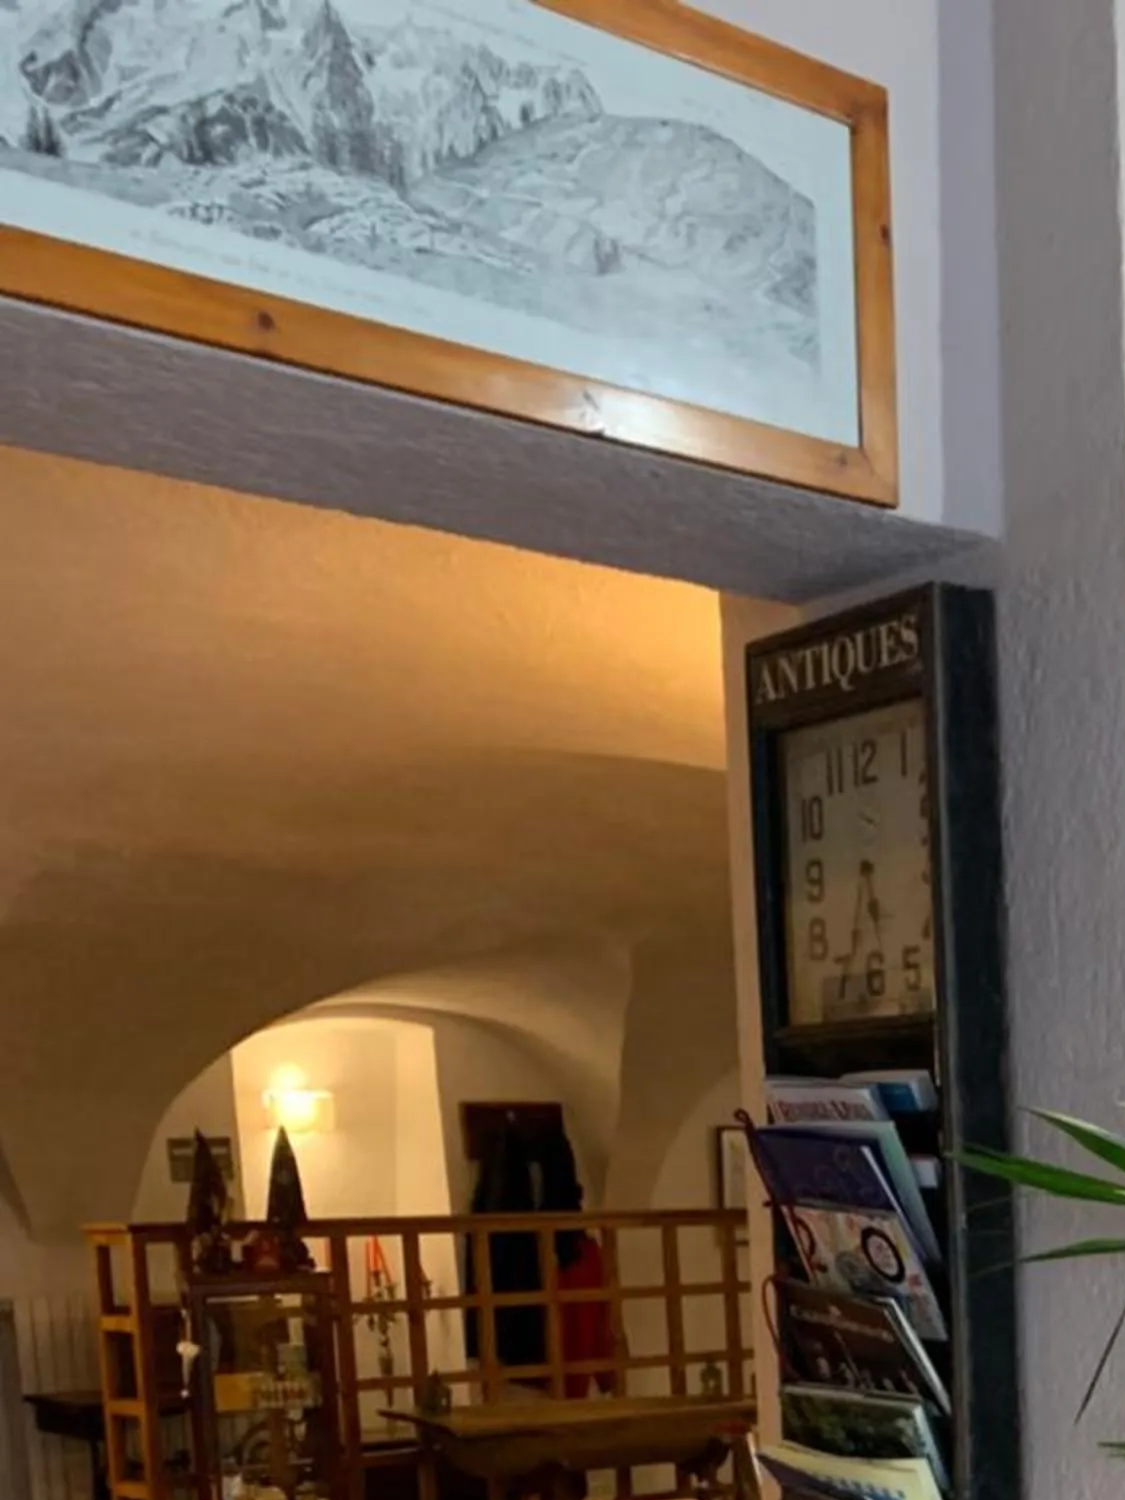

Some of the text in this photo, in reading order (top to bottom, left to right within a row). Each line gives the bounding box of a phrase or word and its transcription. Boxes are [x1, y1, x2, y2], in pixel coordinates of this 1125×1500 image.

[756, 615, 918, 703] ANTIQUES
[826, 746, 843, 795] 11
[853, 740, 879, 785] 12
[900, 731, 908, 777] 1
[801, 796, 823, 842] 10
[805, 860, 825, 904] 9
[808, 919, 828, 961] 8
[833, 955, 852, 999] 7
[865, 950, 887, 996] 6
[901, 946, 922, 991] 5
